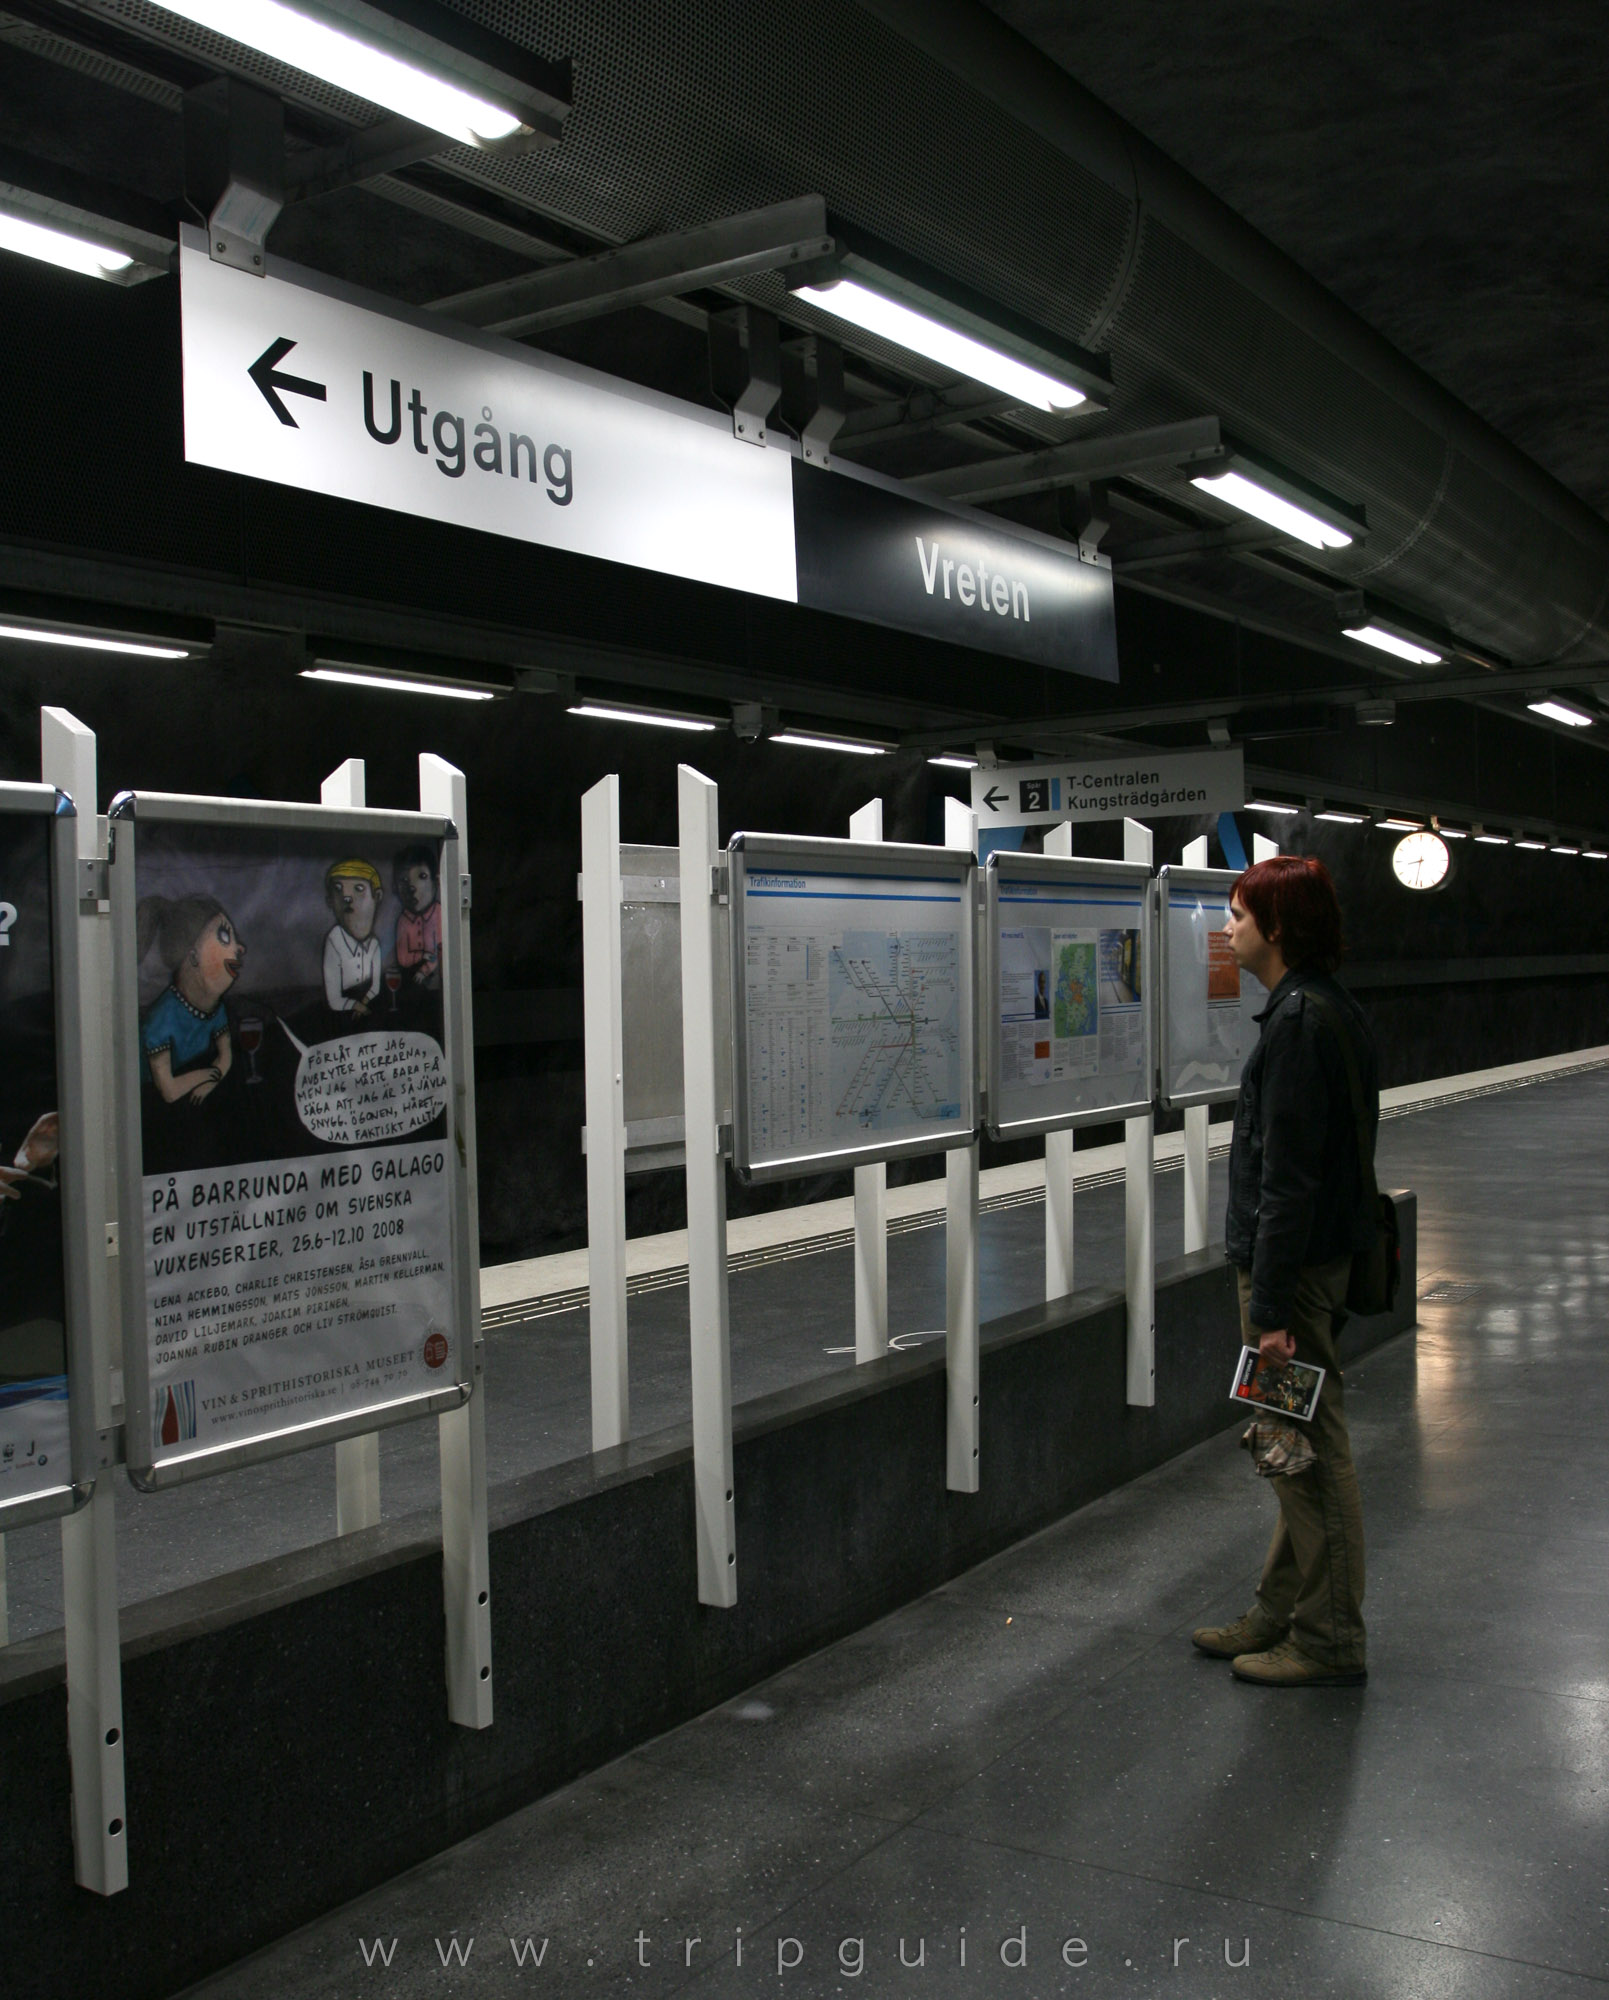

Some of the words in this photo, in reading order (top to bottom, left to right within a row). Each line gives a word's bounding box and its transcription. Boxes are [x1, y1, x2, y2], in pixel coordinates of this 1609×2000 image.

[362, 370, 574, 507] Utgång
[915, 536, 1031, 623] Vreten
[1028, 791, 1041, 810] 2
[1067, 772, 1160, 790] T-Centralen
[1067, 787, 1207, 811] Kungsträdgården
[749, 876, 806, 889] Trafikinformation
[302, 1063, 355, 1088] AVBRYTER
[361, 1048, 427, 1071] HERRARNA,
[308, 1045, 350, 1069] FÖRLÅT
[358, 1043, 377, 1057] ATT
[385, 1038, 405, 1051] JAG
[297, 1085, 322, 1101] MEN
[327, 1082, 346, 1096] JAG
[355, 1071, 386, 1088] MÅSTE
[393, 1065, 419, 1079] BARA
[424, 1056, 440, 1073] FÅ
[304, 1103, 330, 1116] SÄGA
[336, 1097, 352, 1111] ATT
[357, 1091, 378, 1105] JAG
[383, 1083, 397, 1099] ÄR
[401, 1077, 414, 1094] SÅ
[417, 1075, 447, 1091] JÄVLA
[311, 1116, 347, 1130] SNYGG.
[351, 1107, 398, 1126] ÖGONEN,
[355, 1121, 404, 1140] FAKTISKT
[409, 1108, 436, 1129] ALLT!
[152, 1177, 180, 1213] PÅ
[192, 1171, 309, 1208] BARRUNDA
[320, 1163, 362, 1190] MED
[372, 1152, 444, 1182] GALAGO
[153, 1226, 175, 1245] EN
[186, 1206, 307, 1240] UTSTÄLLNING
[315, 1200, 339, 1220] OM
[348, 1189, 413, 1215] SVENSKA
[153, 1239, 283, 1277] VUXENSERIER,
[292, 1225, 365, 1254] 25.6-12.10
[372, 1218, 405, 1240] 2008
[154, 1293, 182, 1309] LENA
[186, 1286, 230, 1303] ACKEBO,
[235, 1275, 279, 1295] CHARLIE
[283, 1263, 354, 1288] CHRISTENSEN,
[358, 1256, 376, 1271] ÅSA
[155, 1312, 183, 1328] NINA
[187, 1295, 268, 1322] HEMMINGSSON,
[273, 1289, 300, 1304] MATS
[354, 1271, 390, 1289] MARTIN
[155, 1329, 189, 1346] DAVID
[261, 1306, 301, 1324] JOAKIM
[155, 1346, 198, 1364] JOANNA
[203, 1338, 239, 1354] RUBIN
[242, 1326, 289, 1346] DRANGER
[292, 1320, 313, 1335] OCH
[316, 1316, 334, 1329] LIV
[201, 1396, 227, 1411] VIN
[230, 1393, 239, 1404] &
[241, 1362, 361, 1402] SPRITHISTORISKA
[366, 1350, 415, 1372] MUSEET
